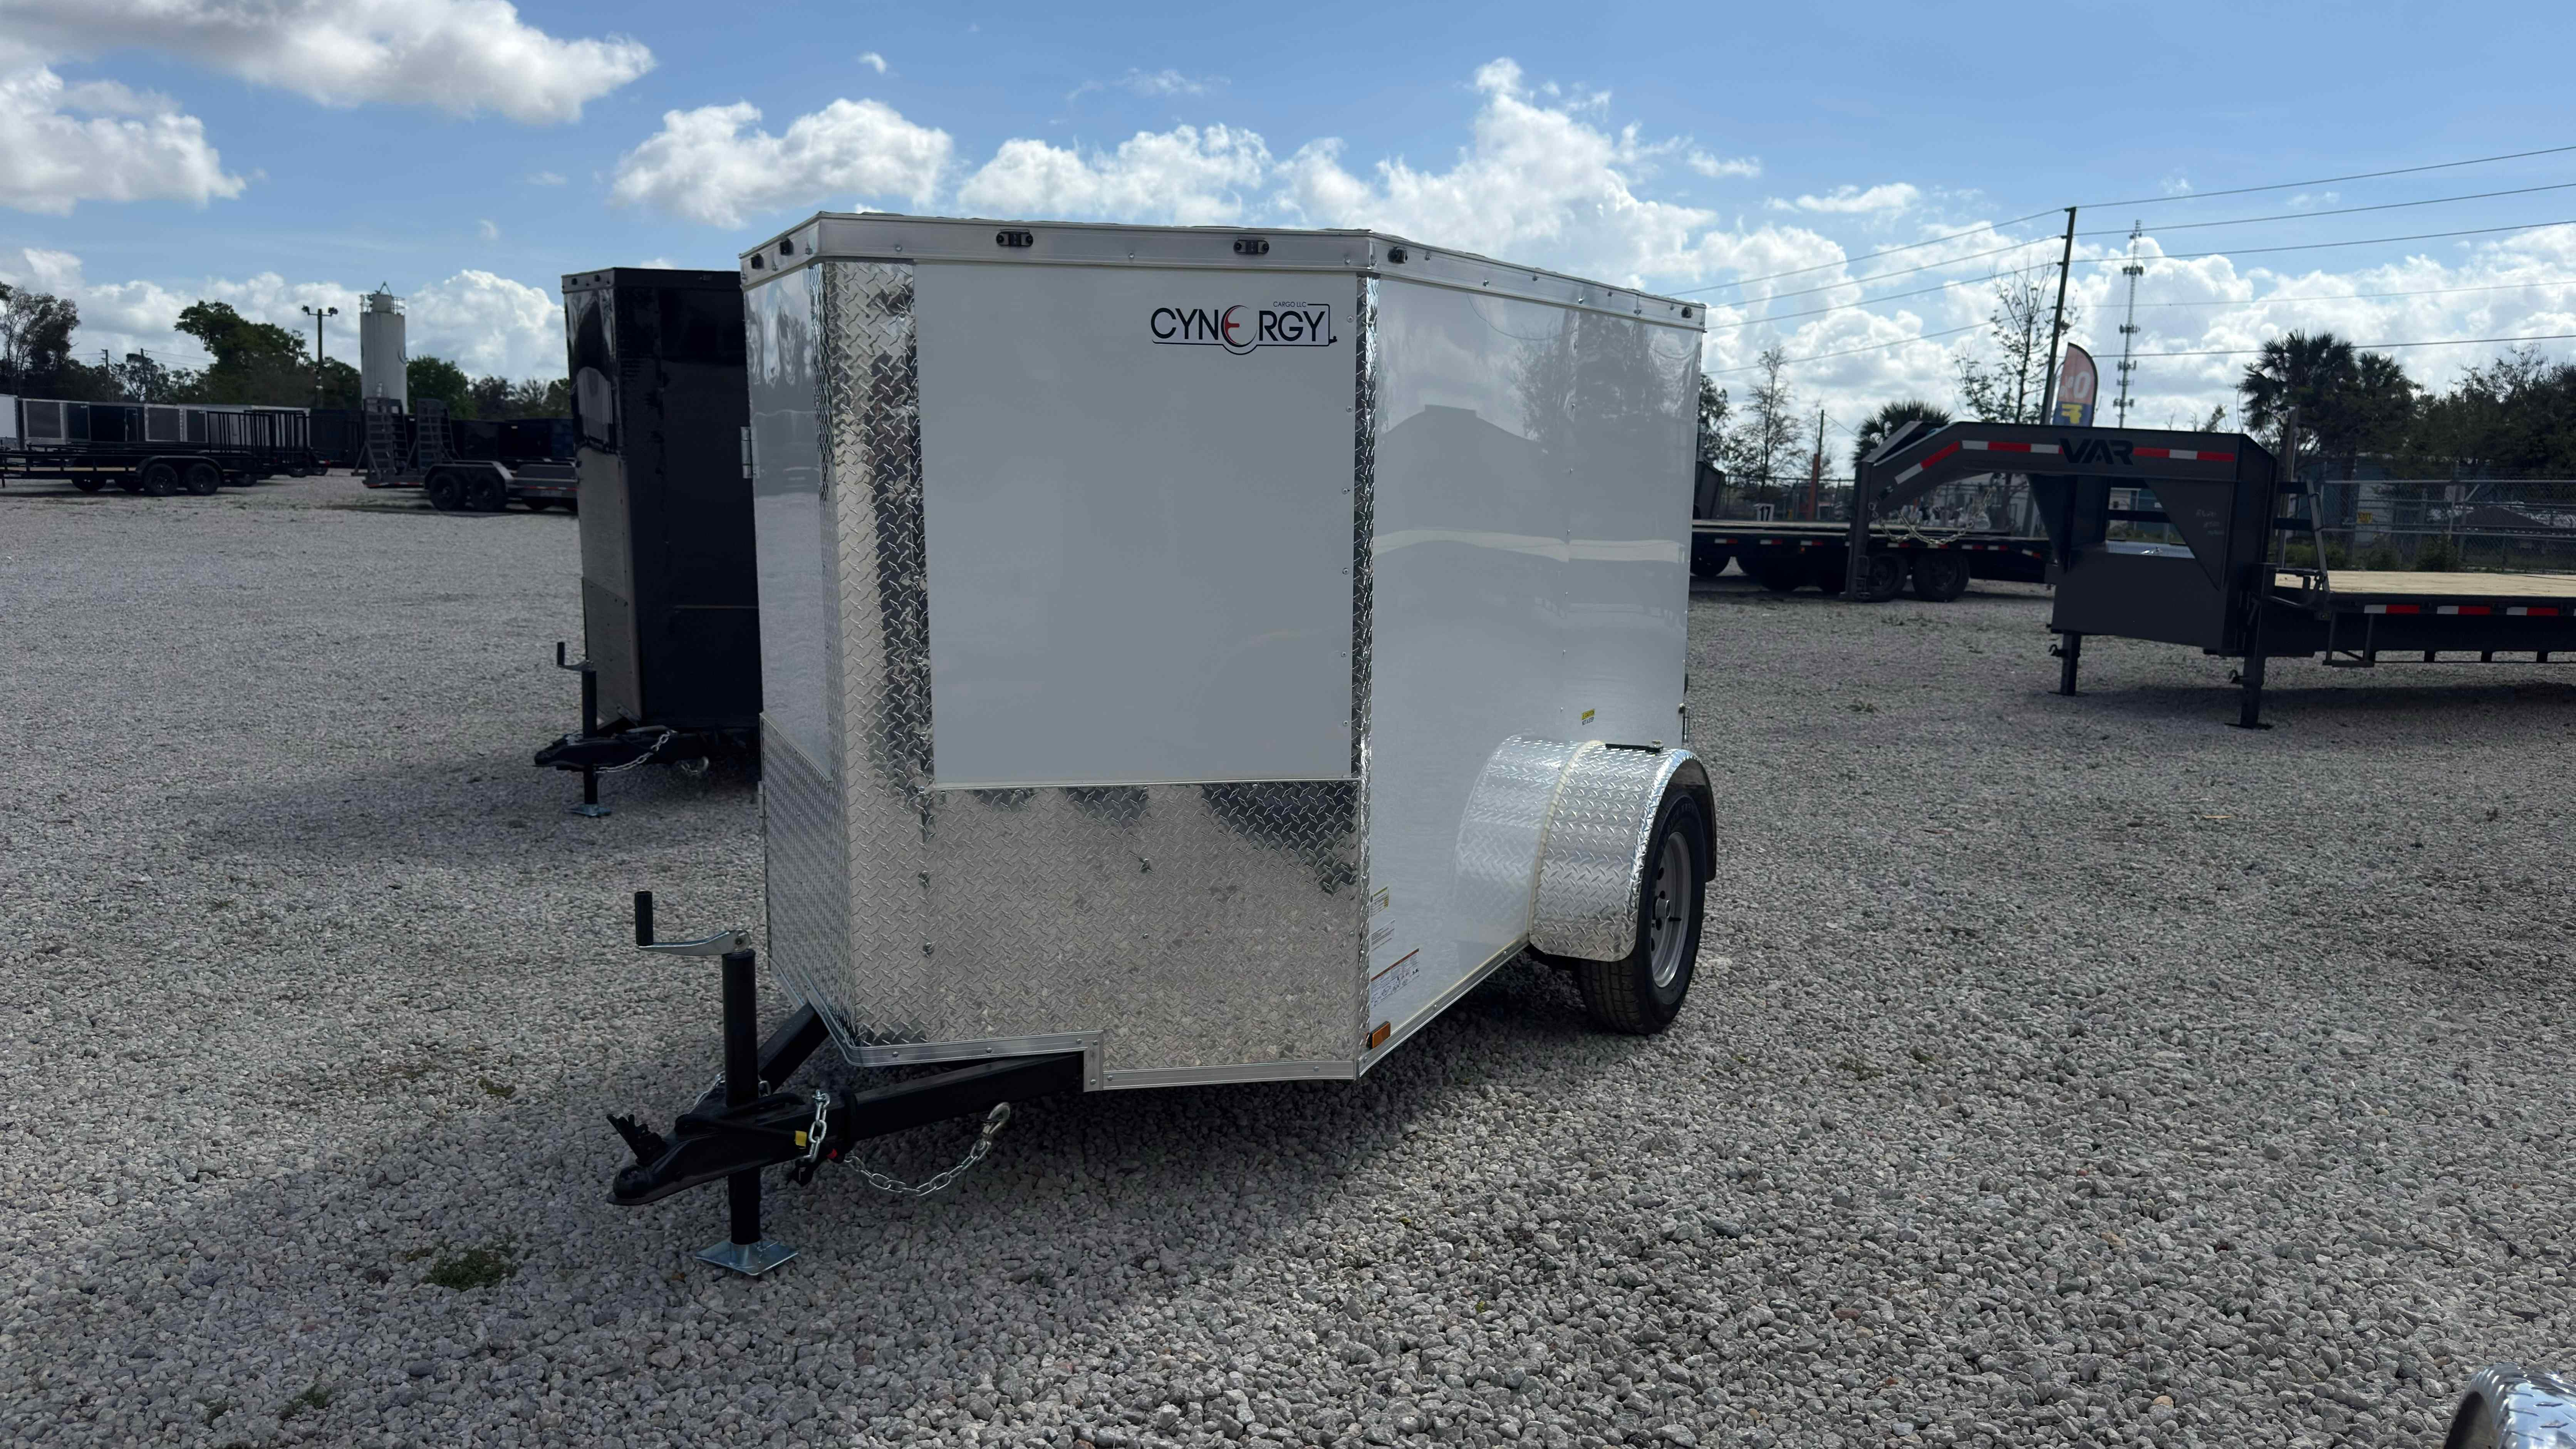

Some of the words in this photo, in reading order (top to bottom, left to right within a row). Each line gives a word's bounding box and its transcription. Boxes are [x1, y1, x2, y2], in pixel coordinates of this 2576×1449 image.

[1151, 305, 1325, 347] CYNERGY
[2059, 438, 2133, 466] VAR
[1759, 506, 1771, 521] 17
